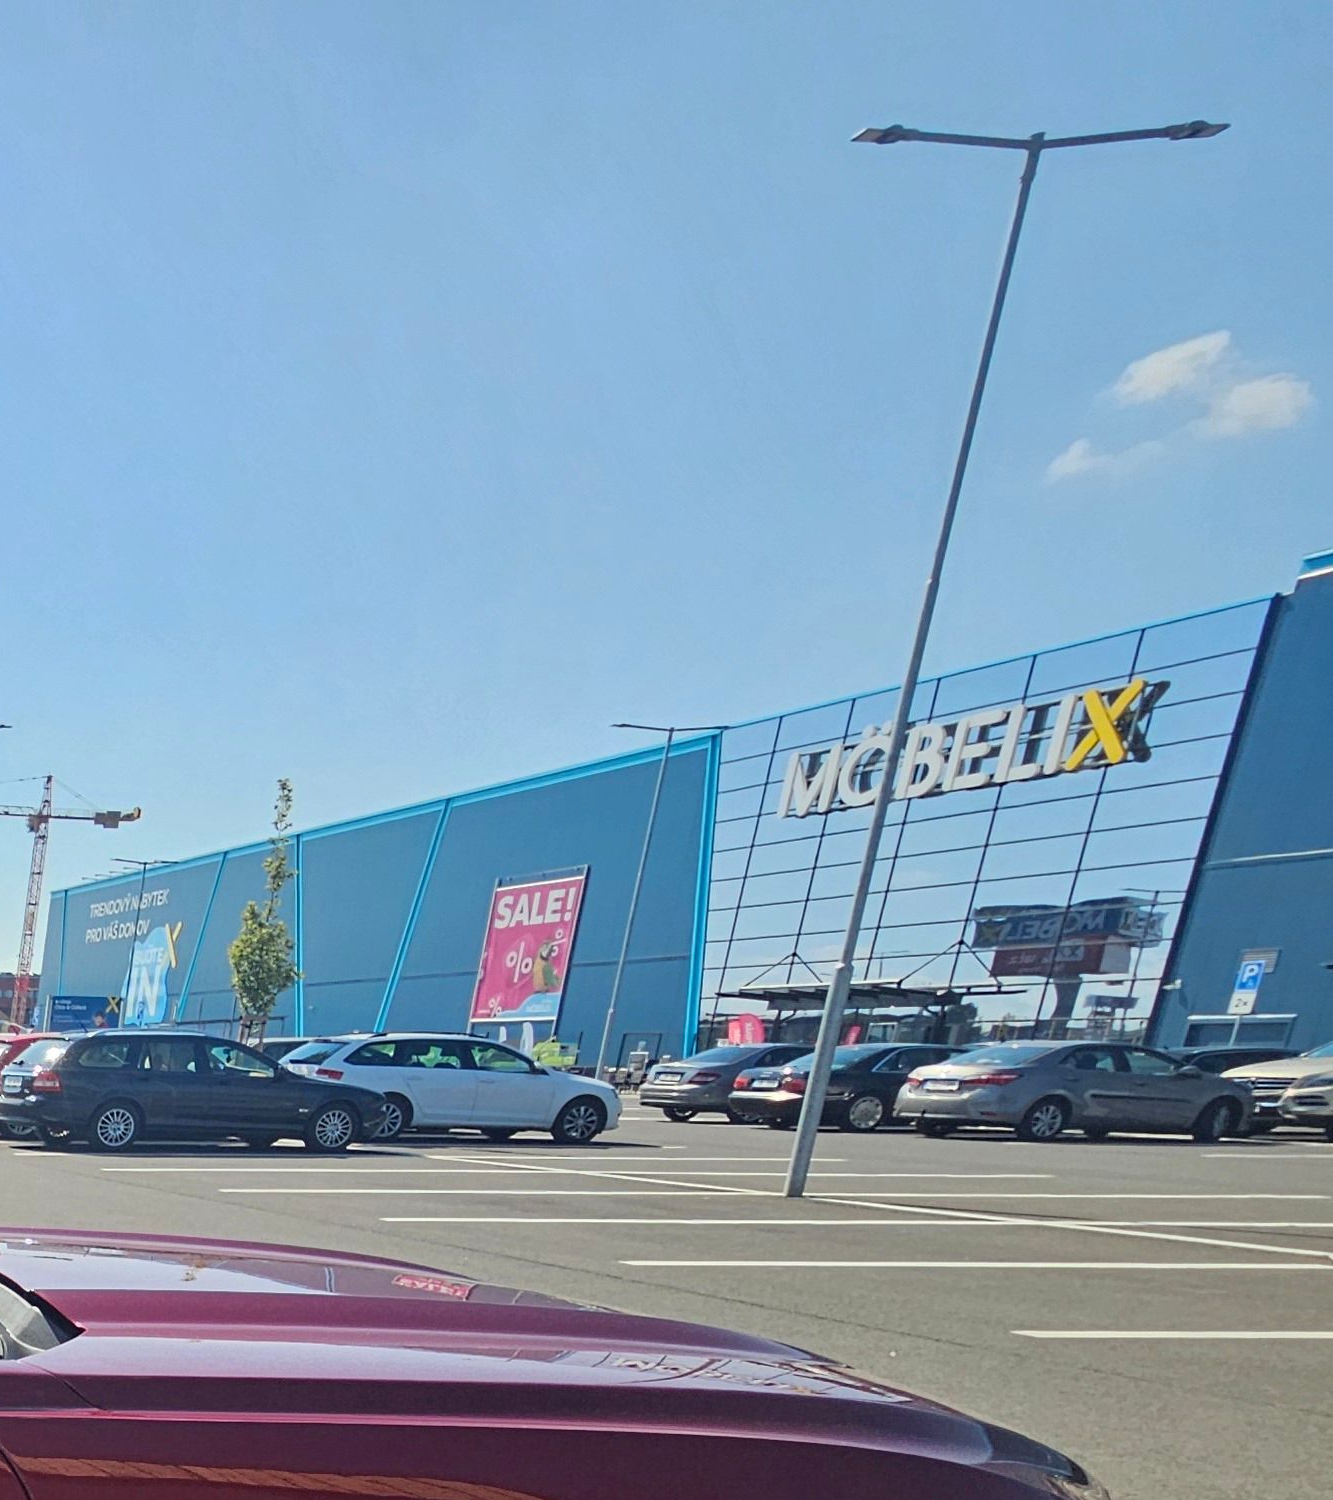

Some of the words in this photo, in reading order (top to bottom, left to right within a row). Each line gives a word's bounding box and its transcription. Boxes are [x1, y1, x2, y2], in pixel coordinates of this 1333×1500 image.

[778, 679, 1148, 819] MÖBELIX
[90, 892, 131, 919] TRENDOVÝ
[494, 887, 576, 929] SALE!
[85, 927, 102, 944] PRO
[103, 920, 118, 940] VÁŠ
[1242, 964, 1259, 983] P
[126, 966, 163, 1017] IN
